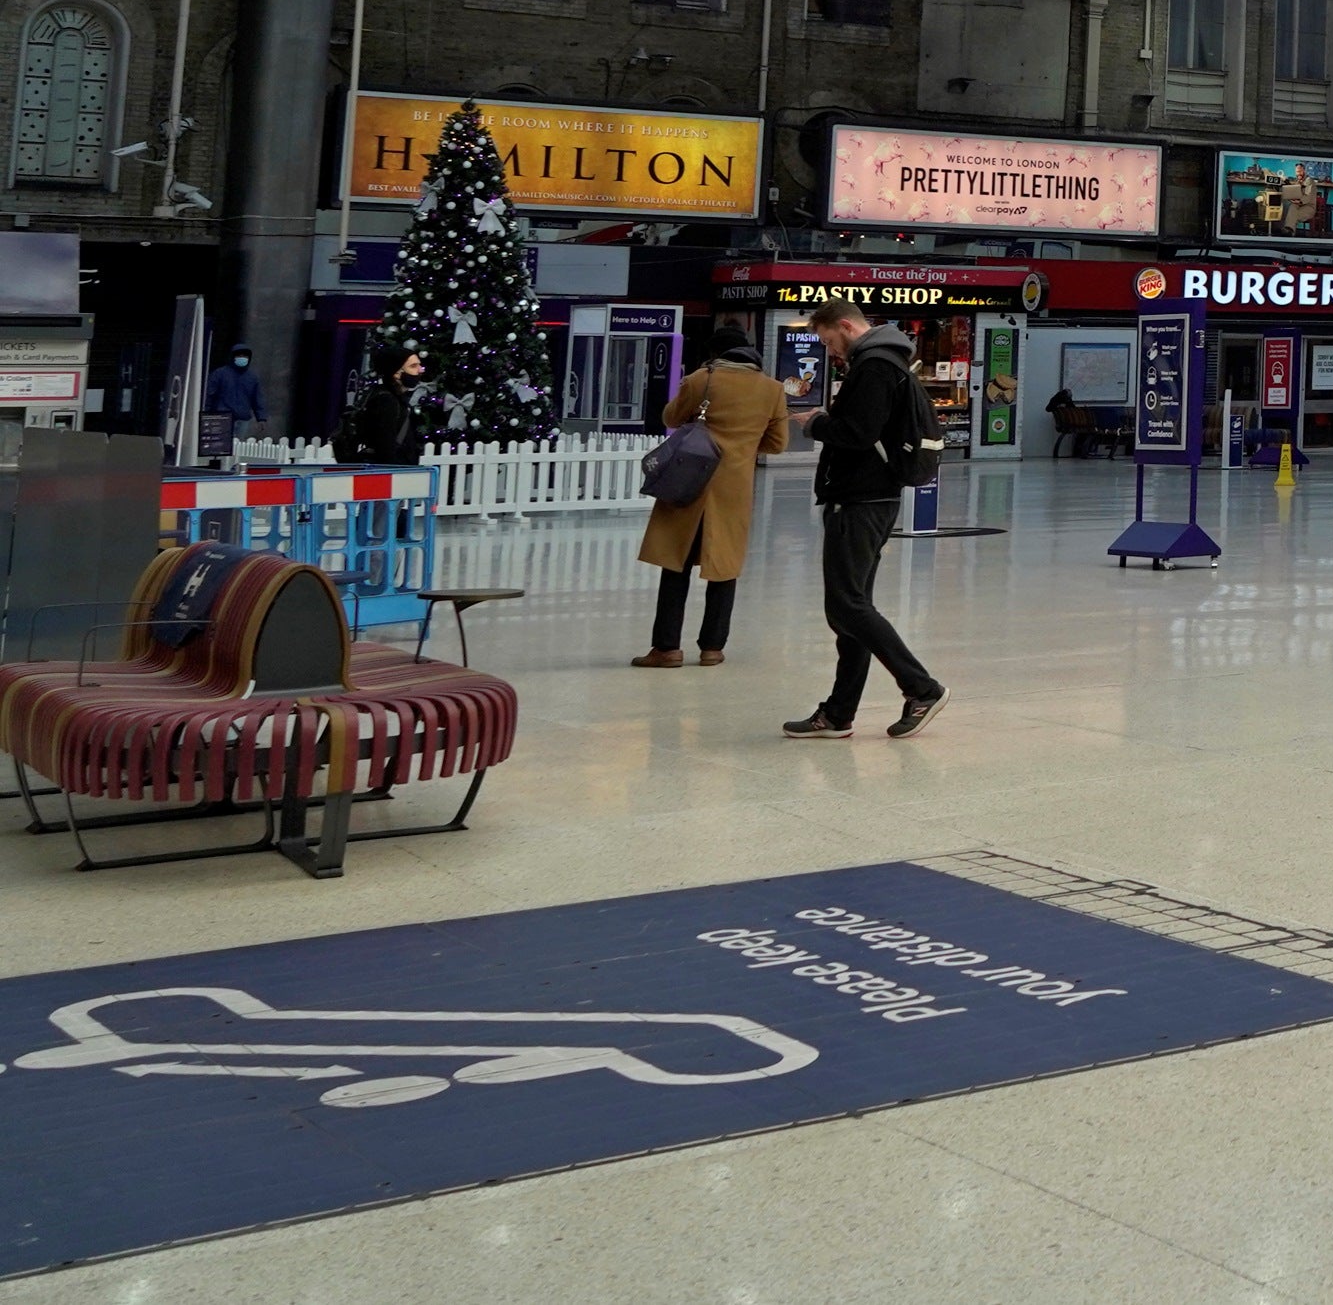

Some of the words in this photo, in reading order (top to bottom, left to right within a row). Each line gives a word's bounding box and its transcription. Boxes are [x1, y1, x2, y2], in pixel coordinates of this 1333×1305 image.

[414, 111, 430, 121] BE
[502, 116, 551, 129] ROOM
[558, 120, 614, 133] WHERE
[621, 124, 635, 134] IT
[642, 127, 708, 138] HAPPENS
[947, 155, 997, 166] WELCOME
[1000, 158, 1013, 167] TO
[1017, 159, 1060, 169] LONDON
[900, 167, 1099, 201] PRETTYLITTLETHING
[623, 195, 666, 204] VICTORIA
[668, 198, 698, 207] PALACE
[700, 199, 737, 208] THEATRE
[976, 205, 1014, 216] clearpay
[870, 268, 903, 281] Taste
[906, 269, 926, 281] the
[927, 269, 947, 283] joy
[777, 288, 798, 302] The
[800, 285, 874, 304] PASTY
[881, 287, 943, 304] SHOP
[1140, 281, 1162, 294] KING
[794, 906, 989, 966] distance
[696, 928, 821, 969] keep
[792, 962, 967, 1022] Please
[960, 966, 1128, 1007] your
